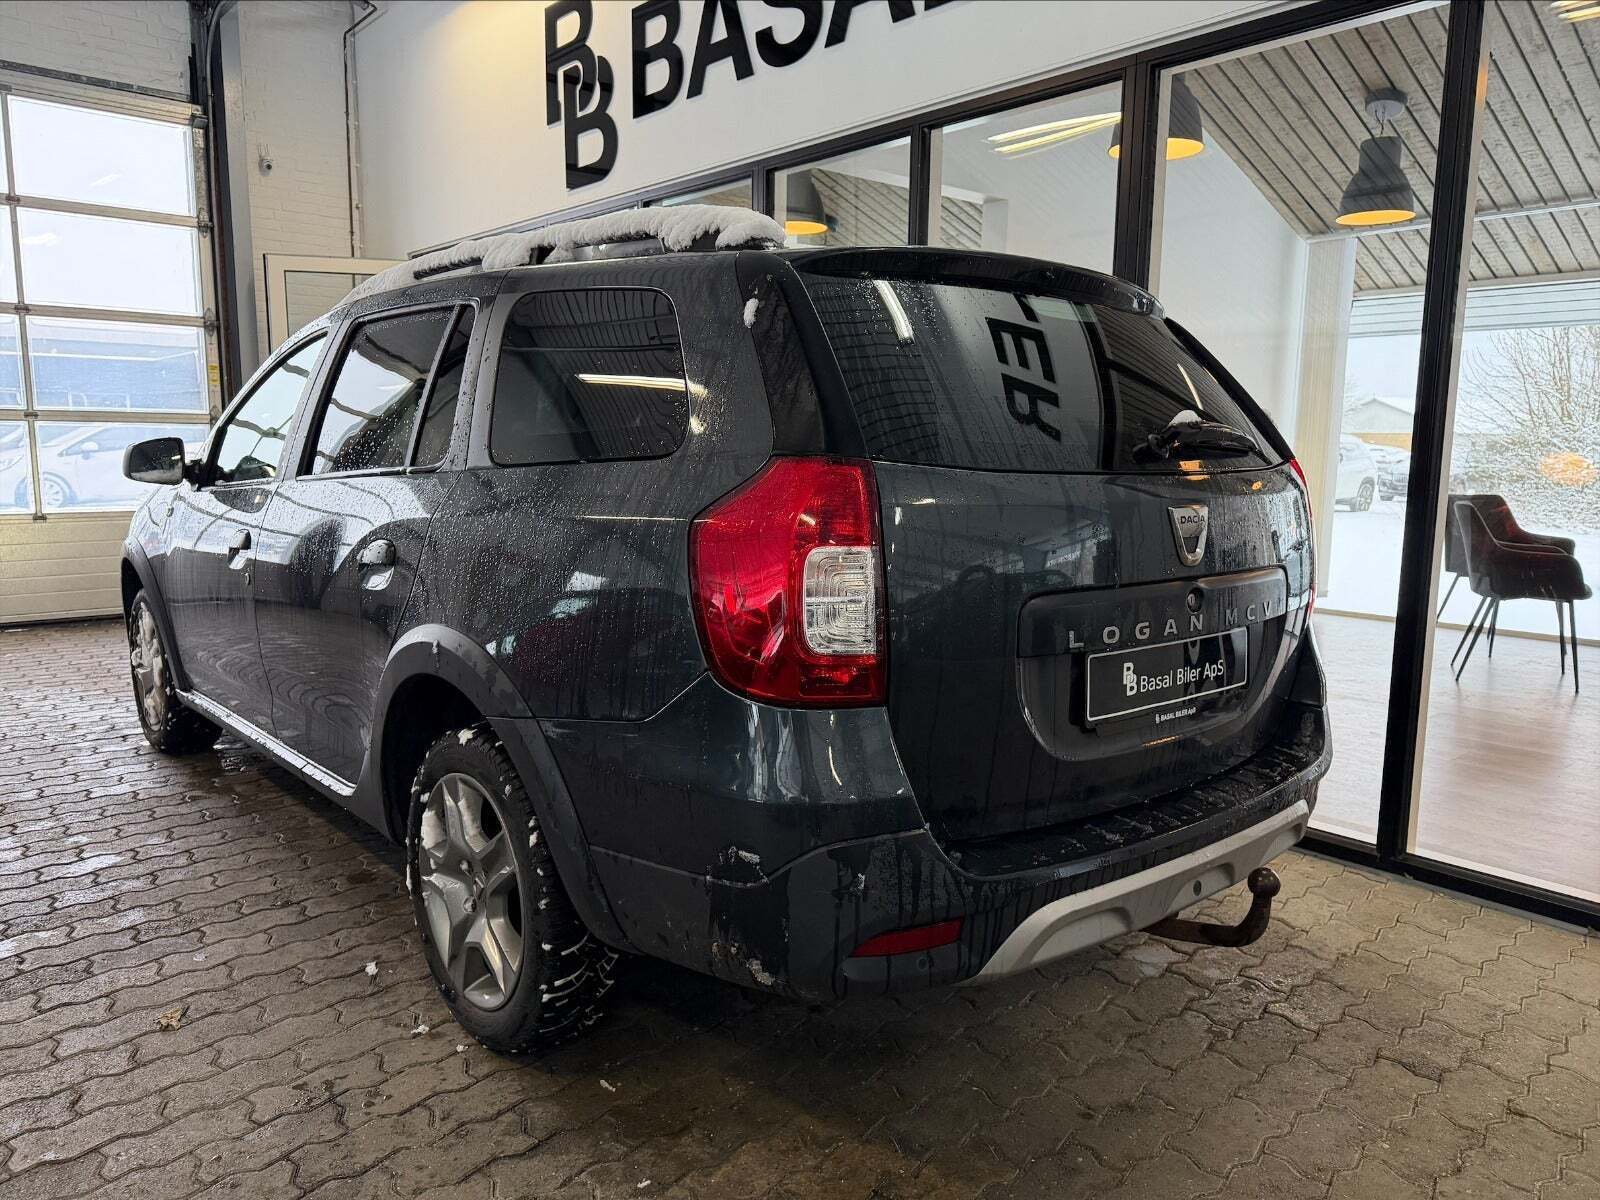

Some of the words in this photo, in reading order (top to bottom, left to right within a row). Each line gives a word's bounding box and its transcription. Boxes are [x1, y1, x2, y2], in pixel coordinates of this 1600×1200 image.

[1180, 514, 1205, 524] DACIA
[1068, 614, 1202, 649] LOGAN
[1225, 601, 1272, 626] MCV
[1140, 669, 1172, 693] Basal
[1176, 666, 1201, 685] Biler
[1202, 659, 1224, 681] ApS
